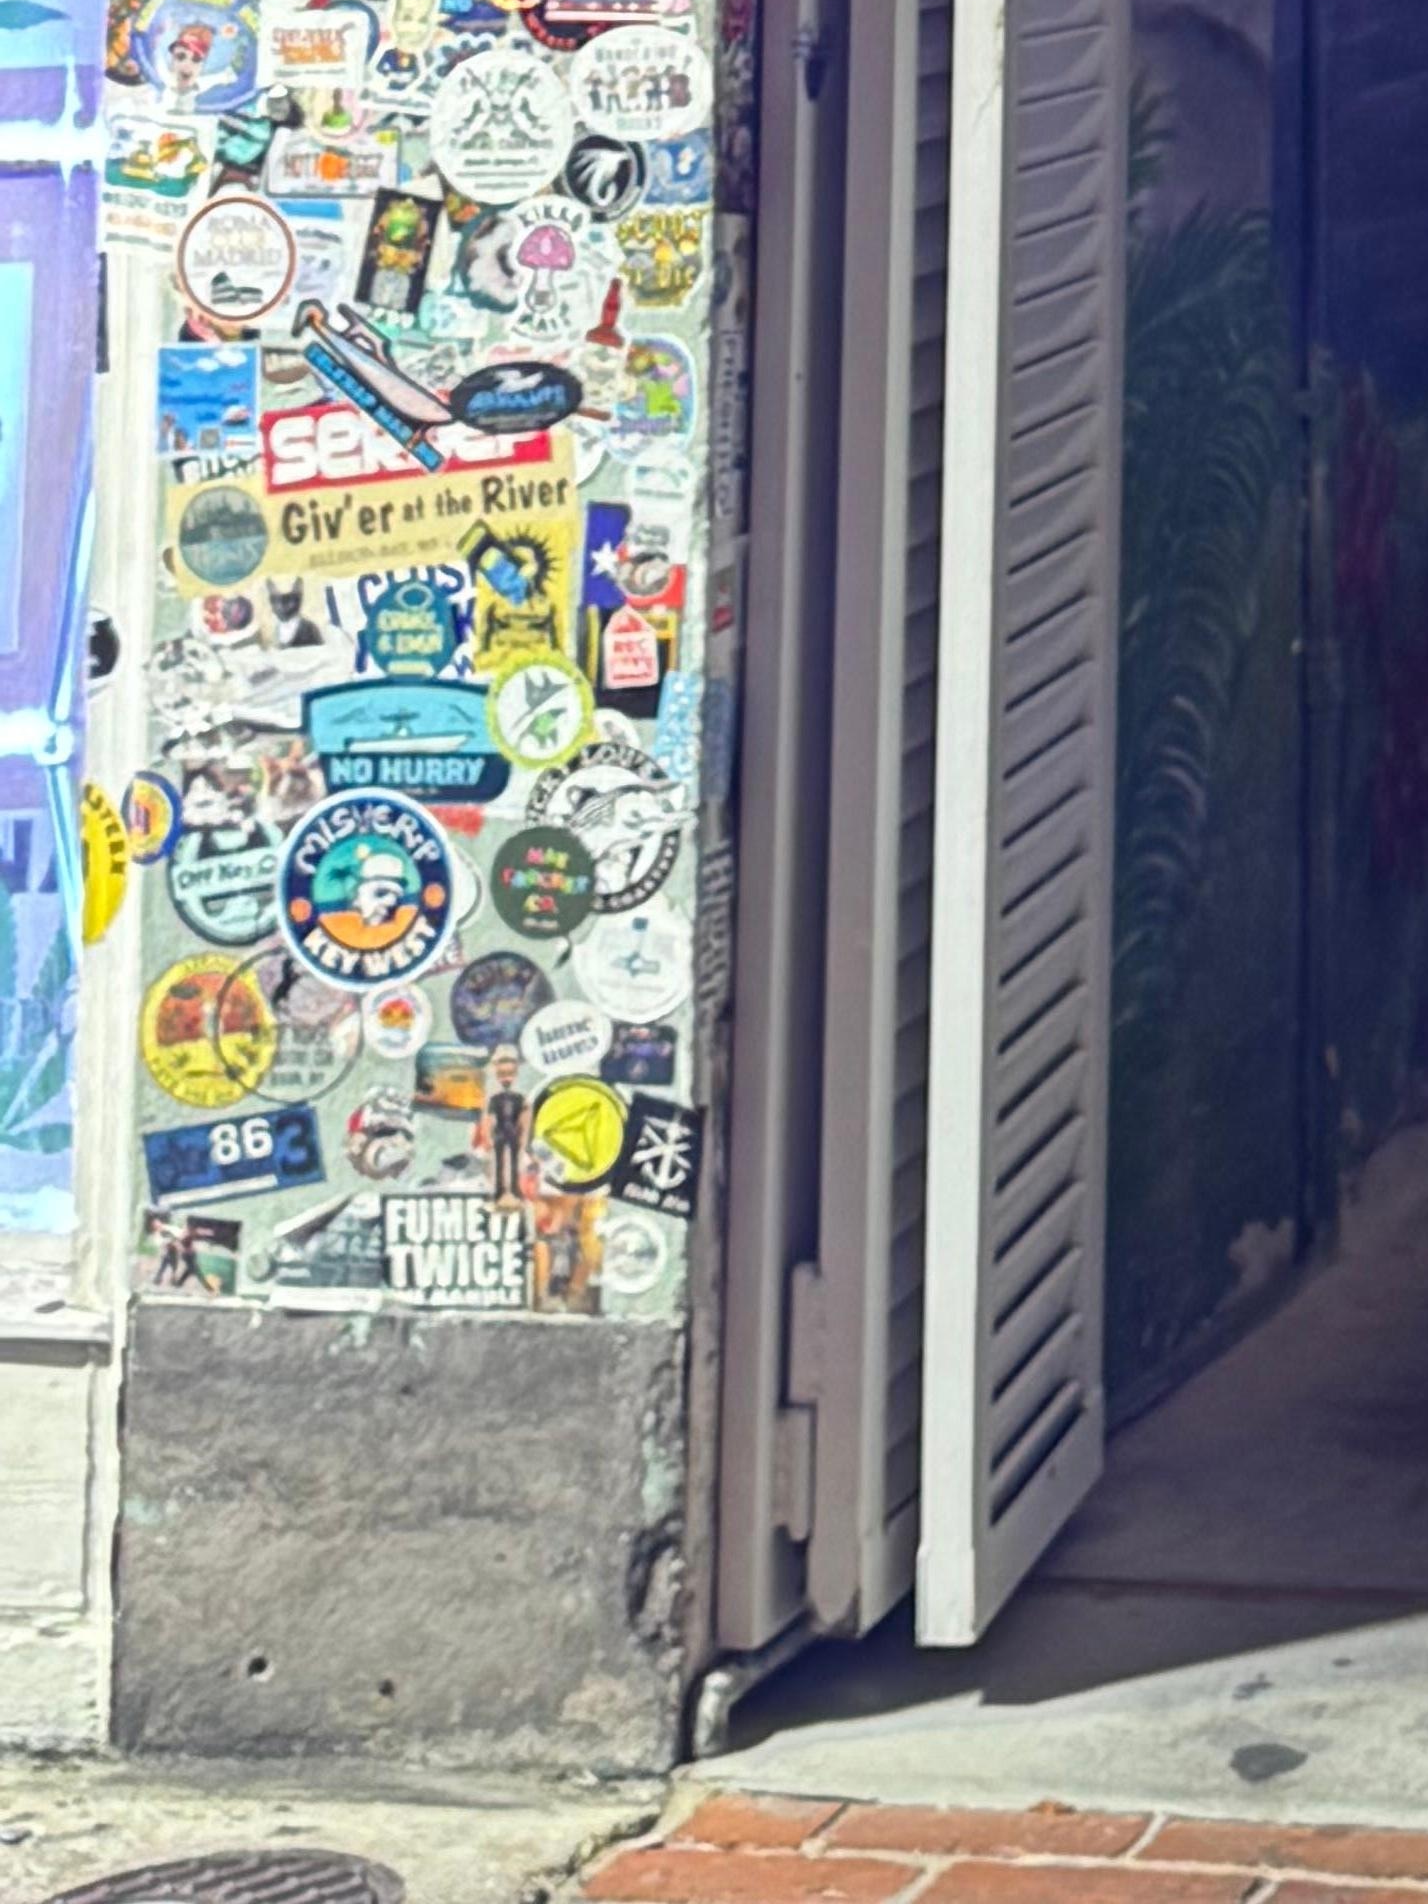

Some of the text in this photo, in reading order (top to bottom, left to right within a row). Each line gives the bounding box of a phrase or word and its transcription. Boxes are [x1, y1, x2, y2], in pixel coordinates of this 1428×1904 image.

[281, 472, 570, 546] Giv'er at the River
[329, 757, 486, 786] NO HURRY
[302, 924, 439, 978] KEY WEST
[383, 1194, 488, 1243] FUME
[385, 1243, 526, 1286] TWICE
